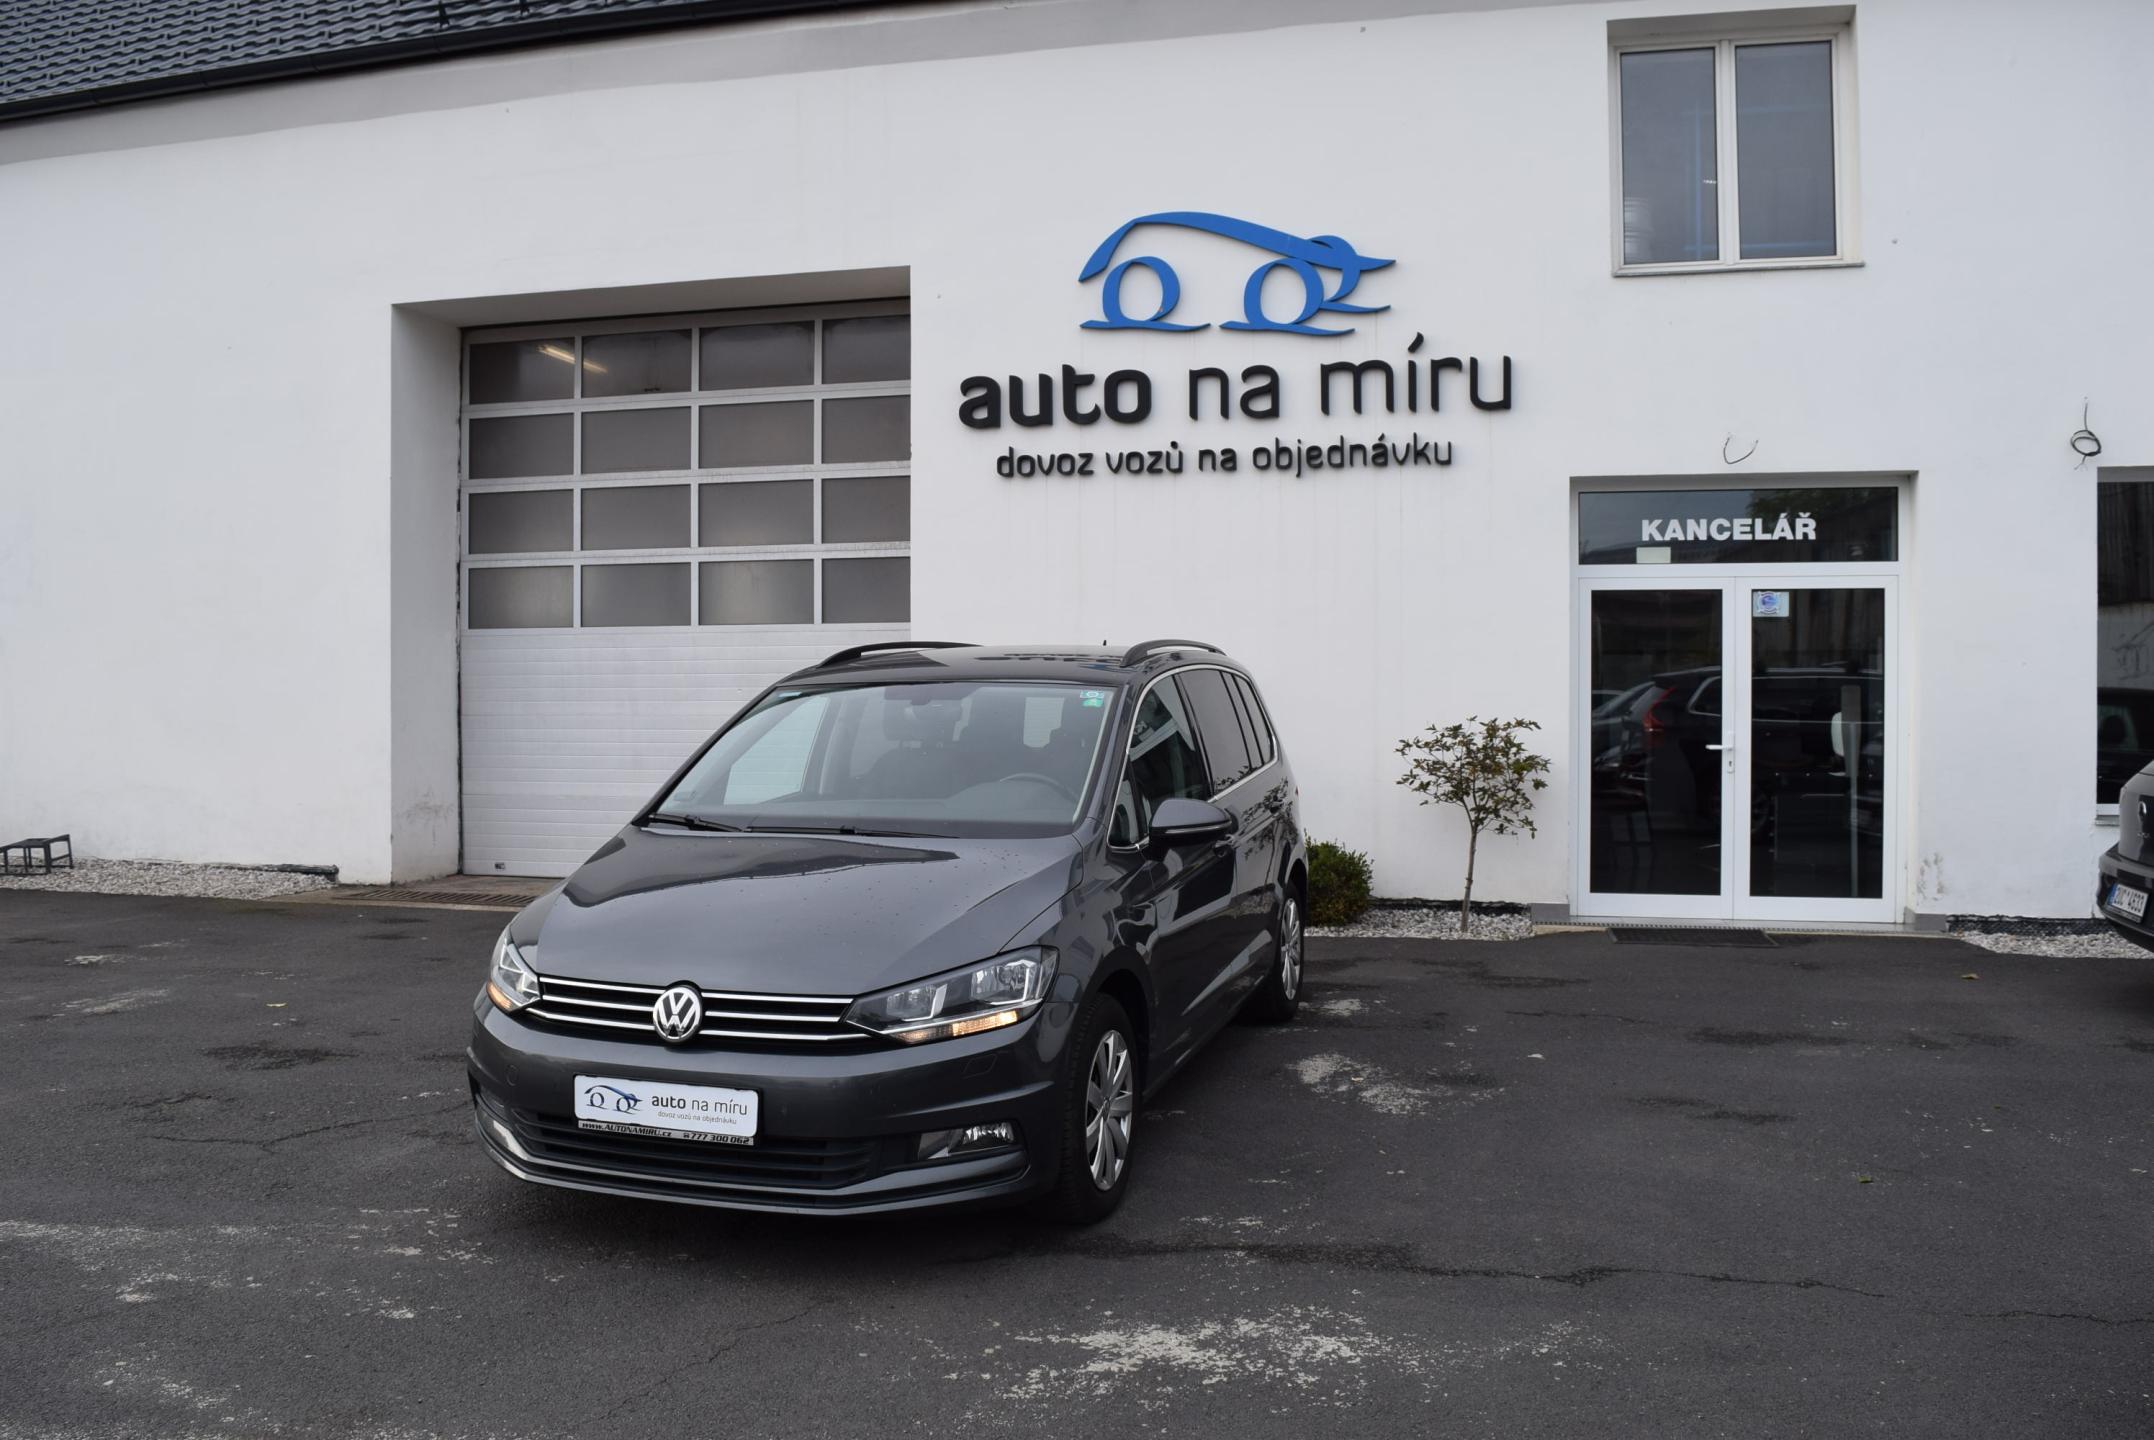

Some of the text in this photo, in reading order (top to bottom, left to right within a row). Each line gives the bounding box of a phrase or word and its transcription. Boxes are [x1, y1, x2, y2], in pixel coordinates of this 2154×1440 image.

[958, 331, 1513, 431] auto na míru
[996, 432, 1453, 479] dovoz vozů na objednávku
[1641, 512, 1817, 542] KANCELÁŘ
[651, 1095, 748, 1116] auto na míru
[657, 1110, 676, 1119] dovoz
